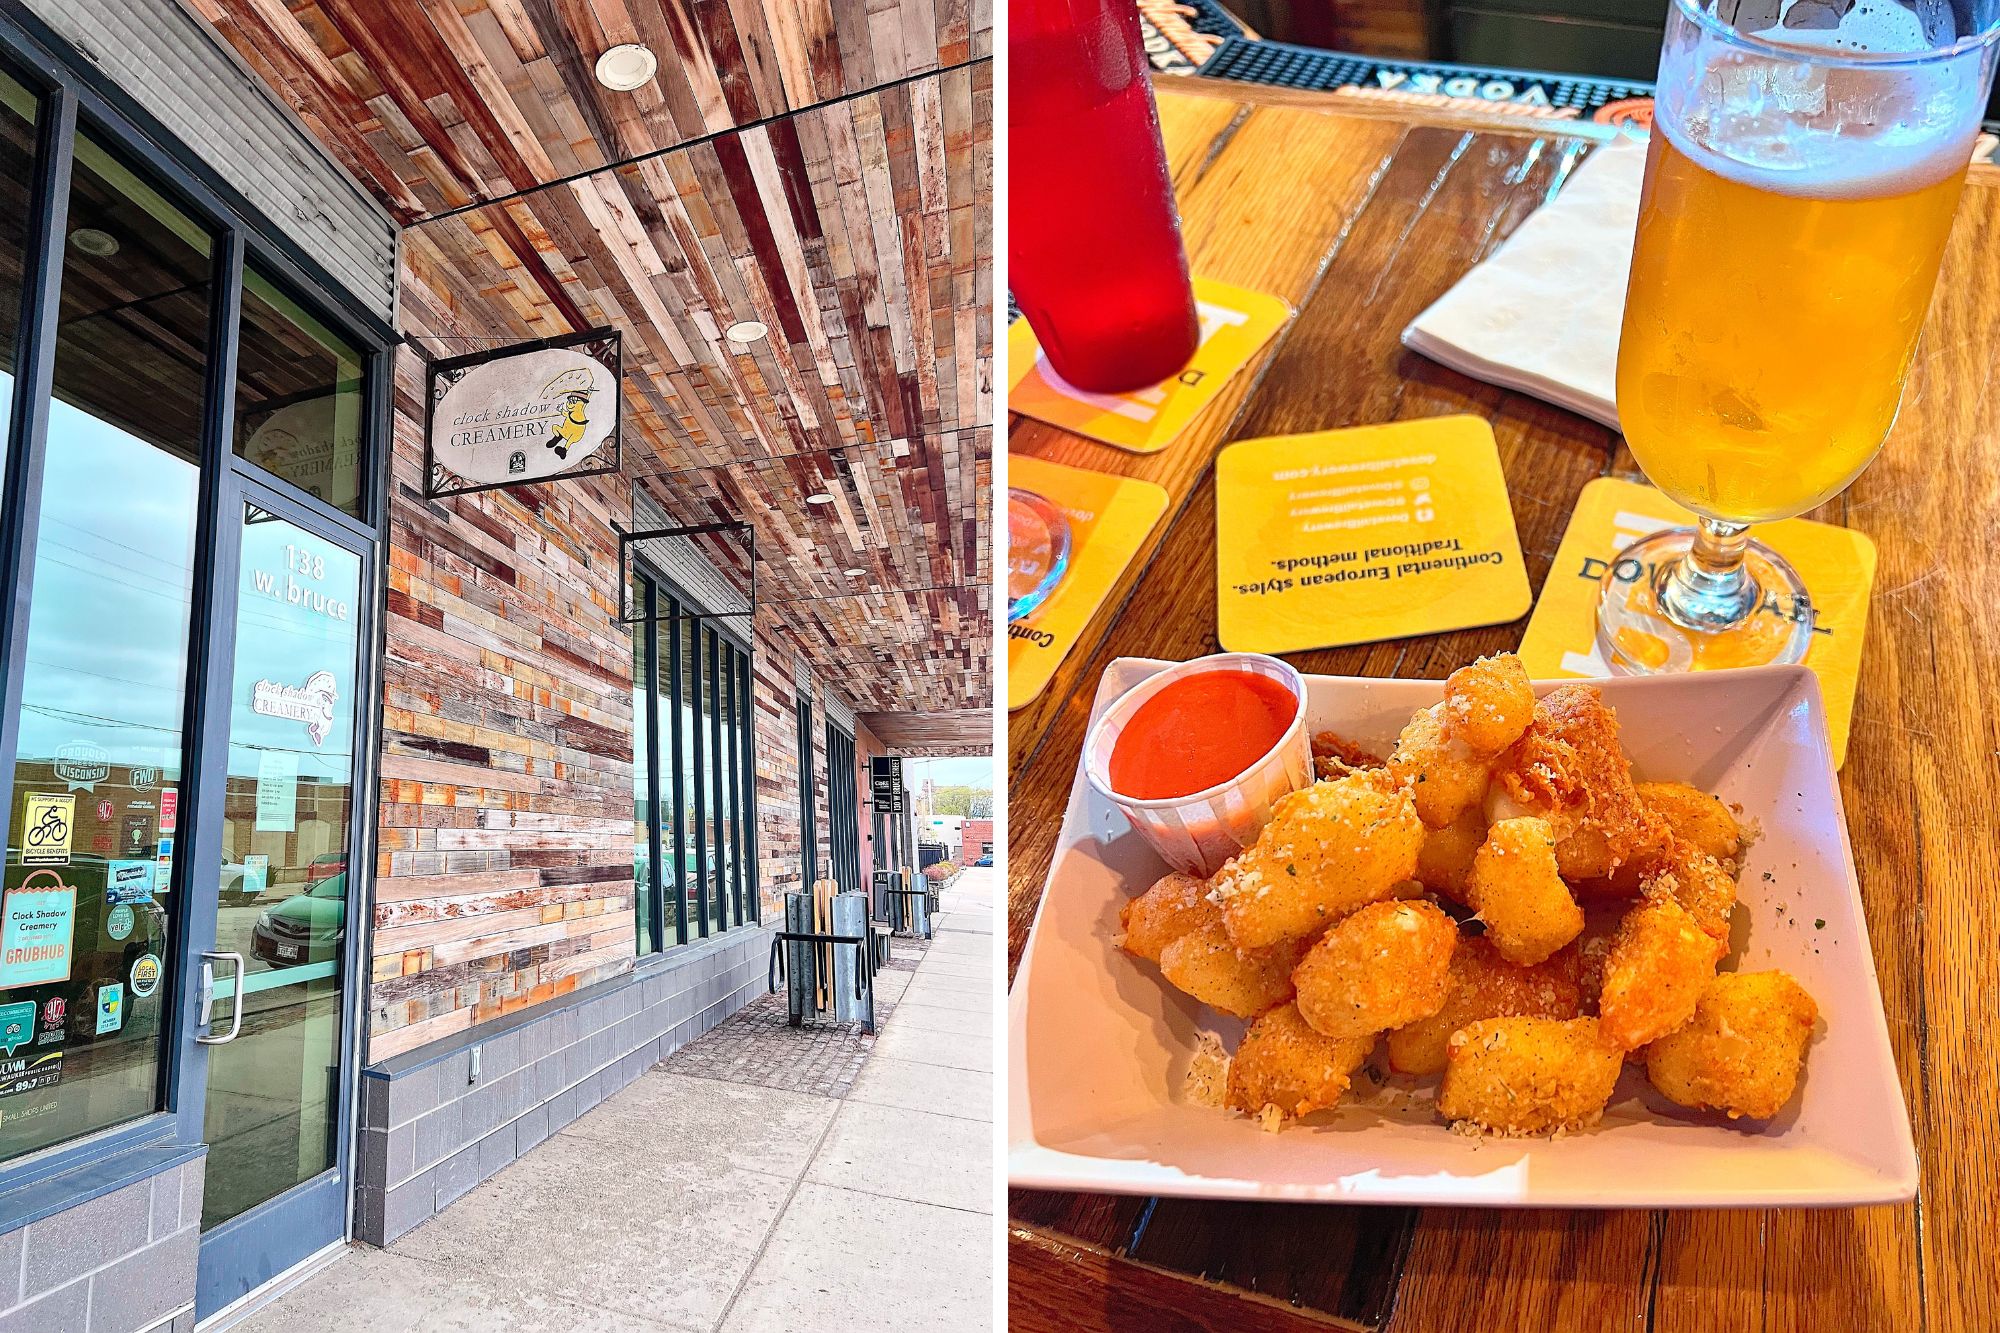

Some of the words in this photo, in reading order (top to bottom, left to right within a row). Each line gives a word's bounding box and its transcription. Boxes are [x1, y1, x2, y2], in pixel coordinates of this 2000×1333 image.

[1376, 70, 1552, 107] VODKA
[453, 409, 490, 426] clock
[496, 402, 551, 420] shadow
[450, 420, 550, 447] CREAMERY
[1365, 537, 1463, 562] Traditional
[286, 544, 326, 580] 138
[1271, 551, 1357, 571] methods.
[1397, 551, 1503, 578] Continental
[1232, 577, 1293, 595] styles.
[1300, 566, 1391, 587] European
[253, 569, 281, 600] w.
[287, 575, 347, 621] bruce
[256, 681, 282, 696] clock
[255, 698, 313, 720] CREAMERY
[59, 764, 105, 780] WISCONSIN
[133, 768, 154, 784] FWD
[892, 759, 900, 777] STREET
[892, 778, 901, 794] BRUCE
[12, 911, 34, 920] Clock
[36, 910, 67, 919] Shadow
[19, 923, 58, 931] Creamery
[110, 923, 124, 933] yelp
[6, 944, 65, 964] GRUBHUB
[0, 1059, 26, 1075] UWM
[39, 1074, 59, 1086] npr
[2, 1113, 19, 1122] SMALL
[21, 1107, 39, 1117] SHOPS
[40, 1101, 58, 1112] UNITED
